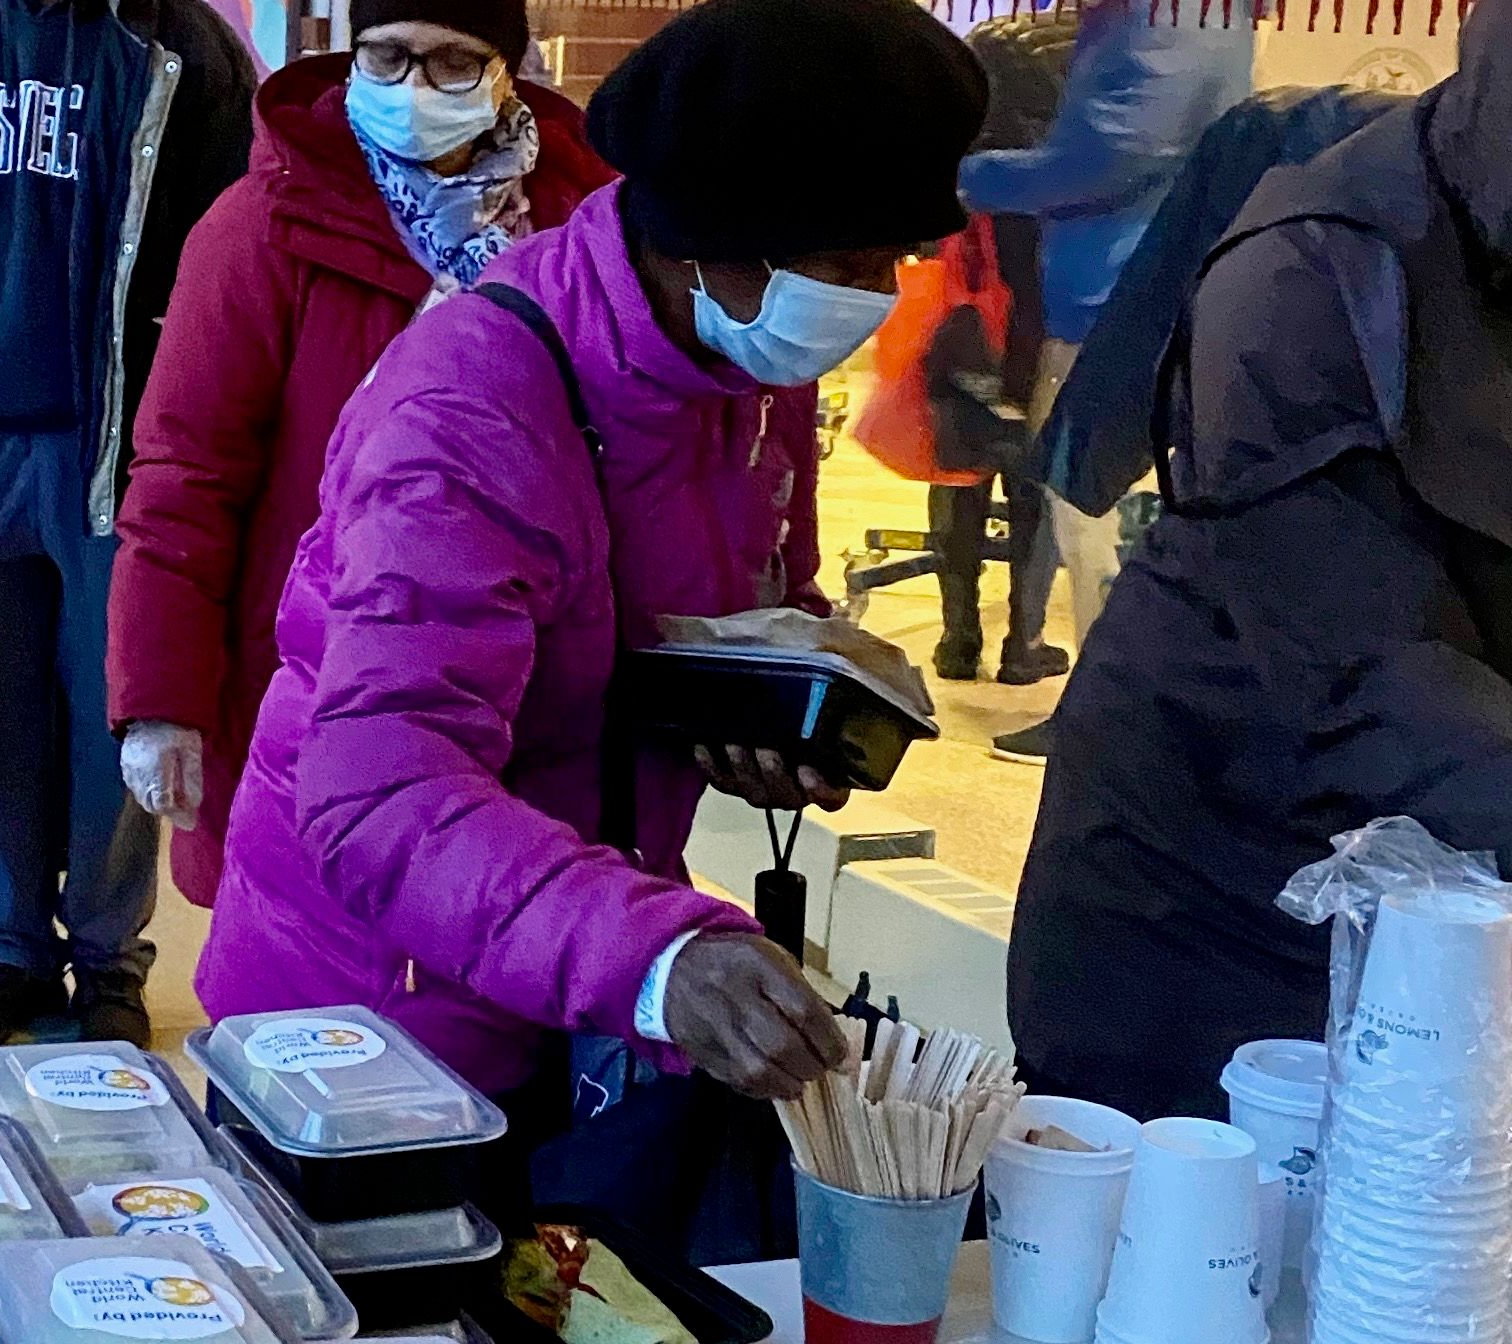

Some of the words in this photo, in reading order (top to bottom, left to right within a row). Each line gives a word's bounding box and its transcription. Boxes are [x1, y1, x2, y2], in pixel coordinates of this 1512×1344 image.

[1377, 1018, 1440, 1042] LEMONS
[1208, 1254, 1252, 1270] OLIVES
[130, 1312, 223, 1322] Provided
